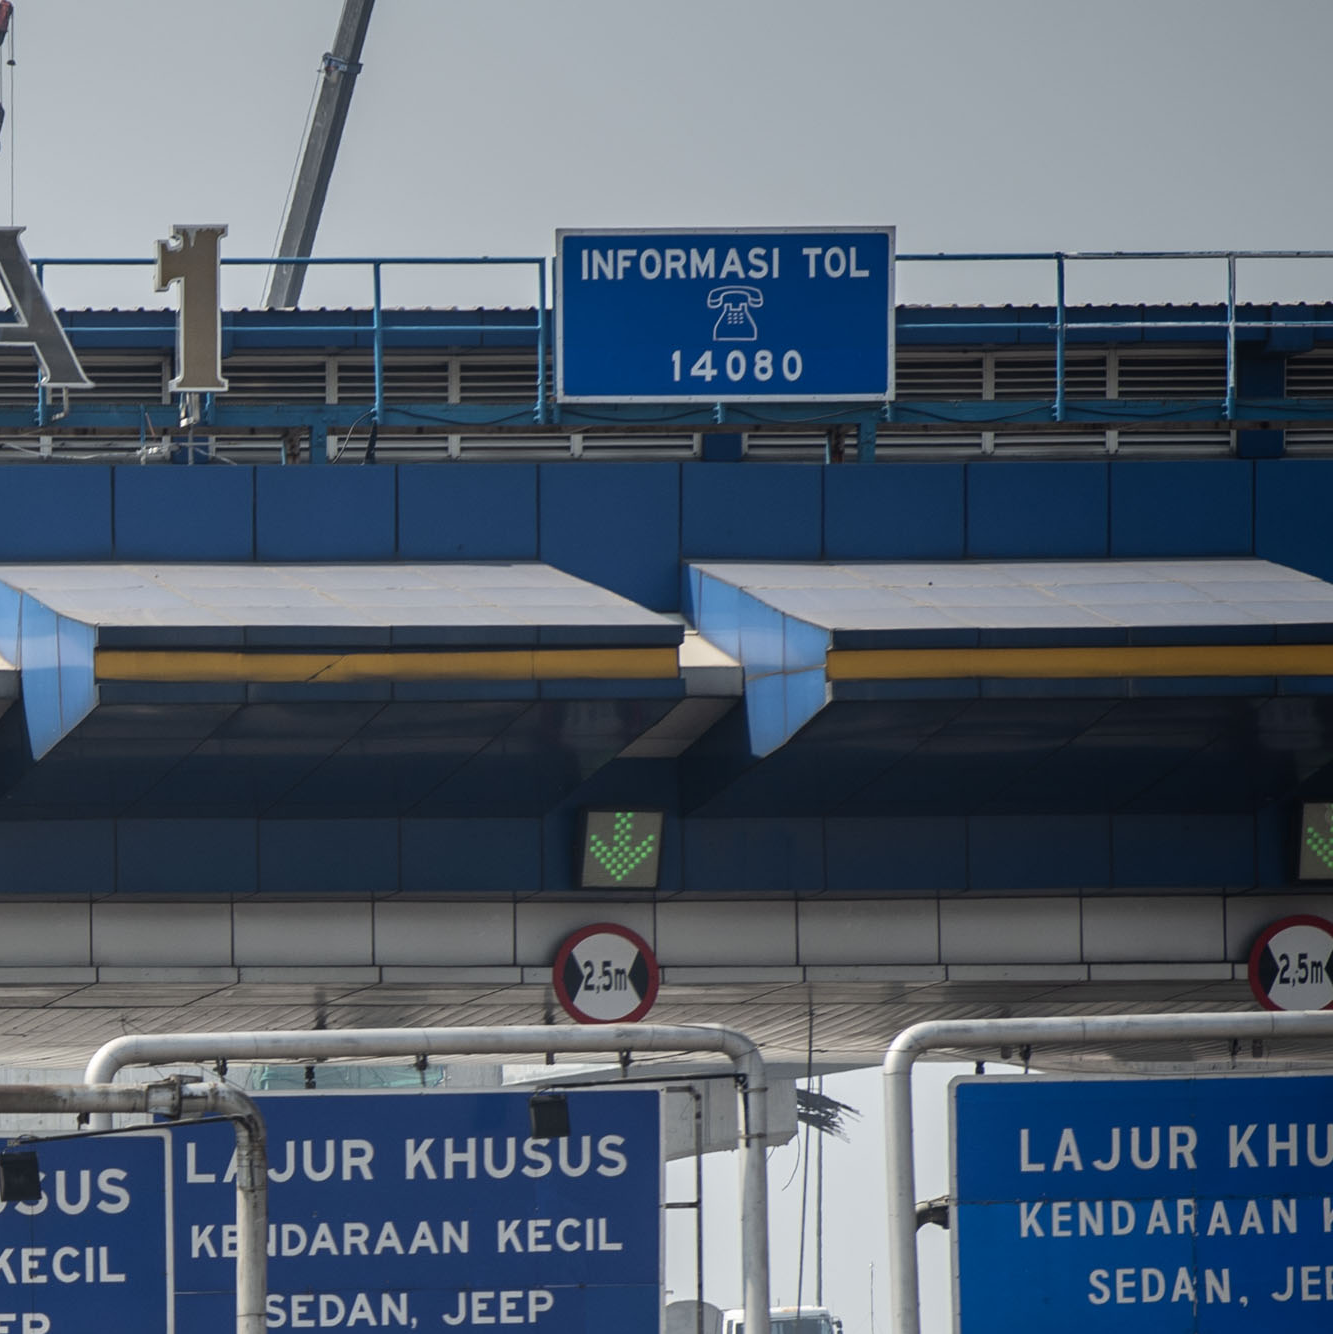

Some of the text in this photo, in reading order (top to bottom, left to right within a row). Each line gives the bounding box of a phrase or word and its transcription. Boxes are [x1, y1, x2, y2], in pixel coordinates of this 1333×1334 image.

[581, 247, 870, 280] INFORMASI TOL
[153, 223, 229, 392] 1
[671, 350, 803, 382] 14080
[404, 1134, 628, 1181] KHUSUS
[1019, 1125, 1199, 1172] LAJUR
[497, 1217, 624, 1253] KECIL
[1019, 1198, 1298, 1238] KENDARAAN
[1087, 1266, 1249, 1307] SEDAN,
[265, 1290, 555, 1329] SEDAN, JEEP
